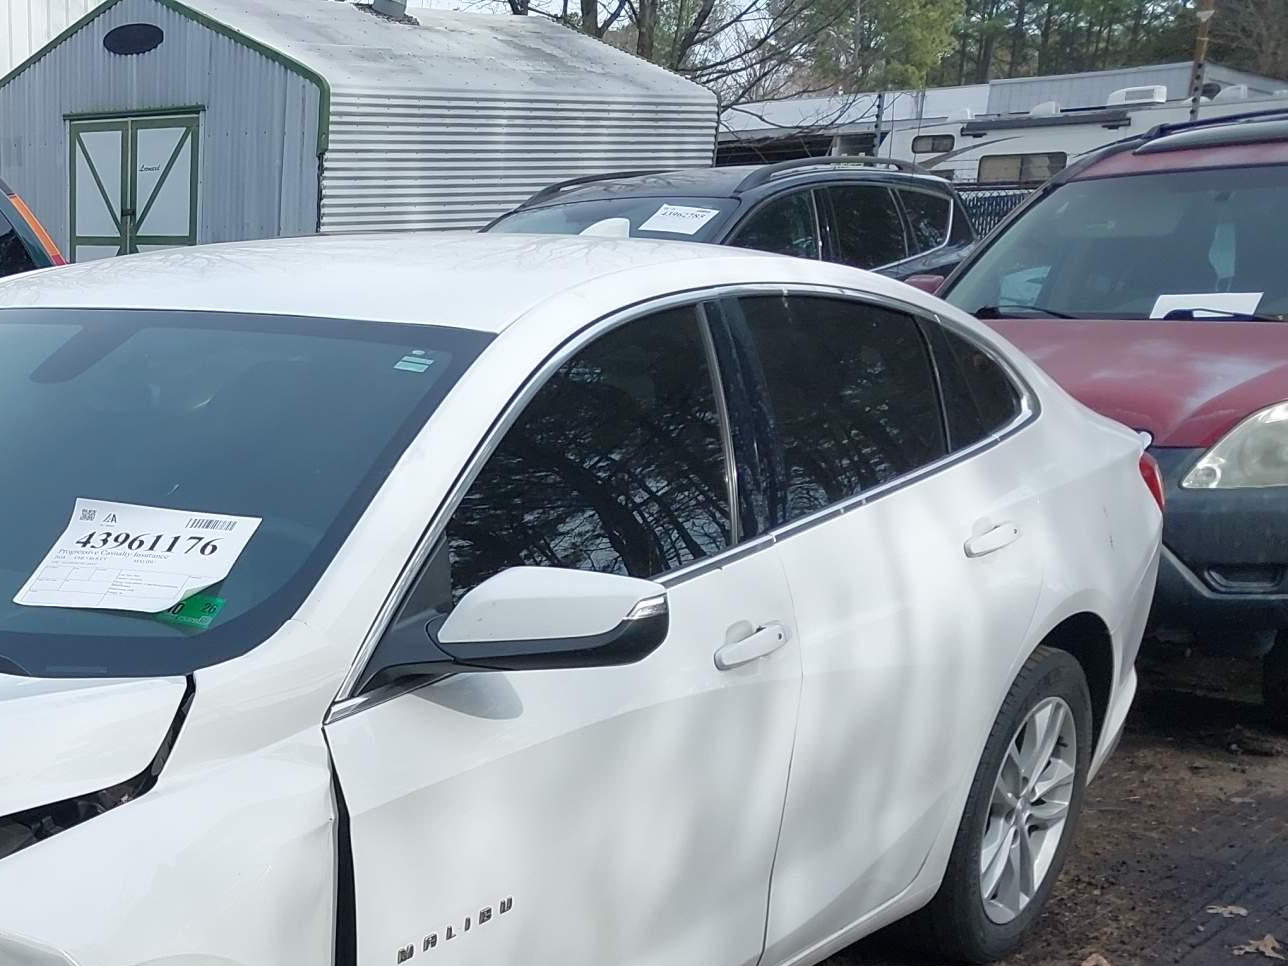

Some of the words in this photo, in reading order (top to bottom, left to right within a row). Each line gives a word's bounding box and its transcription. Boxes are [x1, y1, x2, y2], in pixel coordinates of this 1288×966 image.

[75, 529, 224, 557] 43961176
[57, 548, 99, 556] Progressive
[100, 549, 131, 558] Casualty
[133, 551, 170, 560] Insurance
[200, 602, 219, 614] 26
[397, 896, 514, 965] MALIBU
